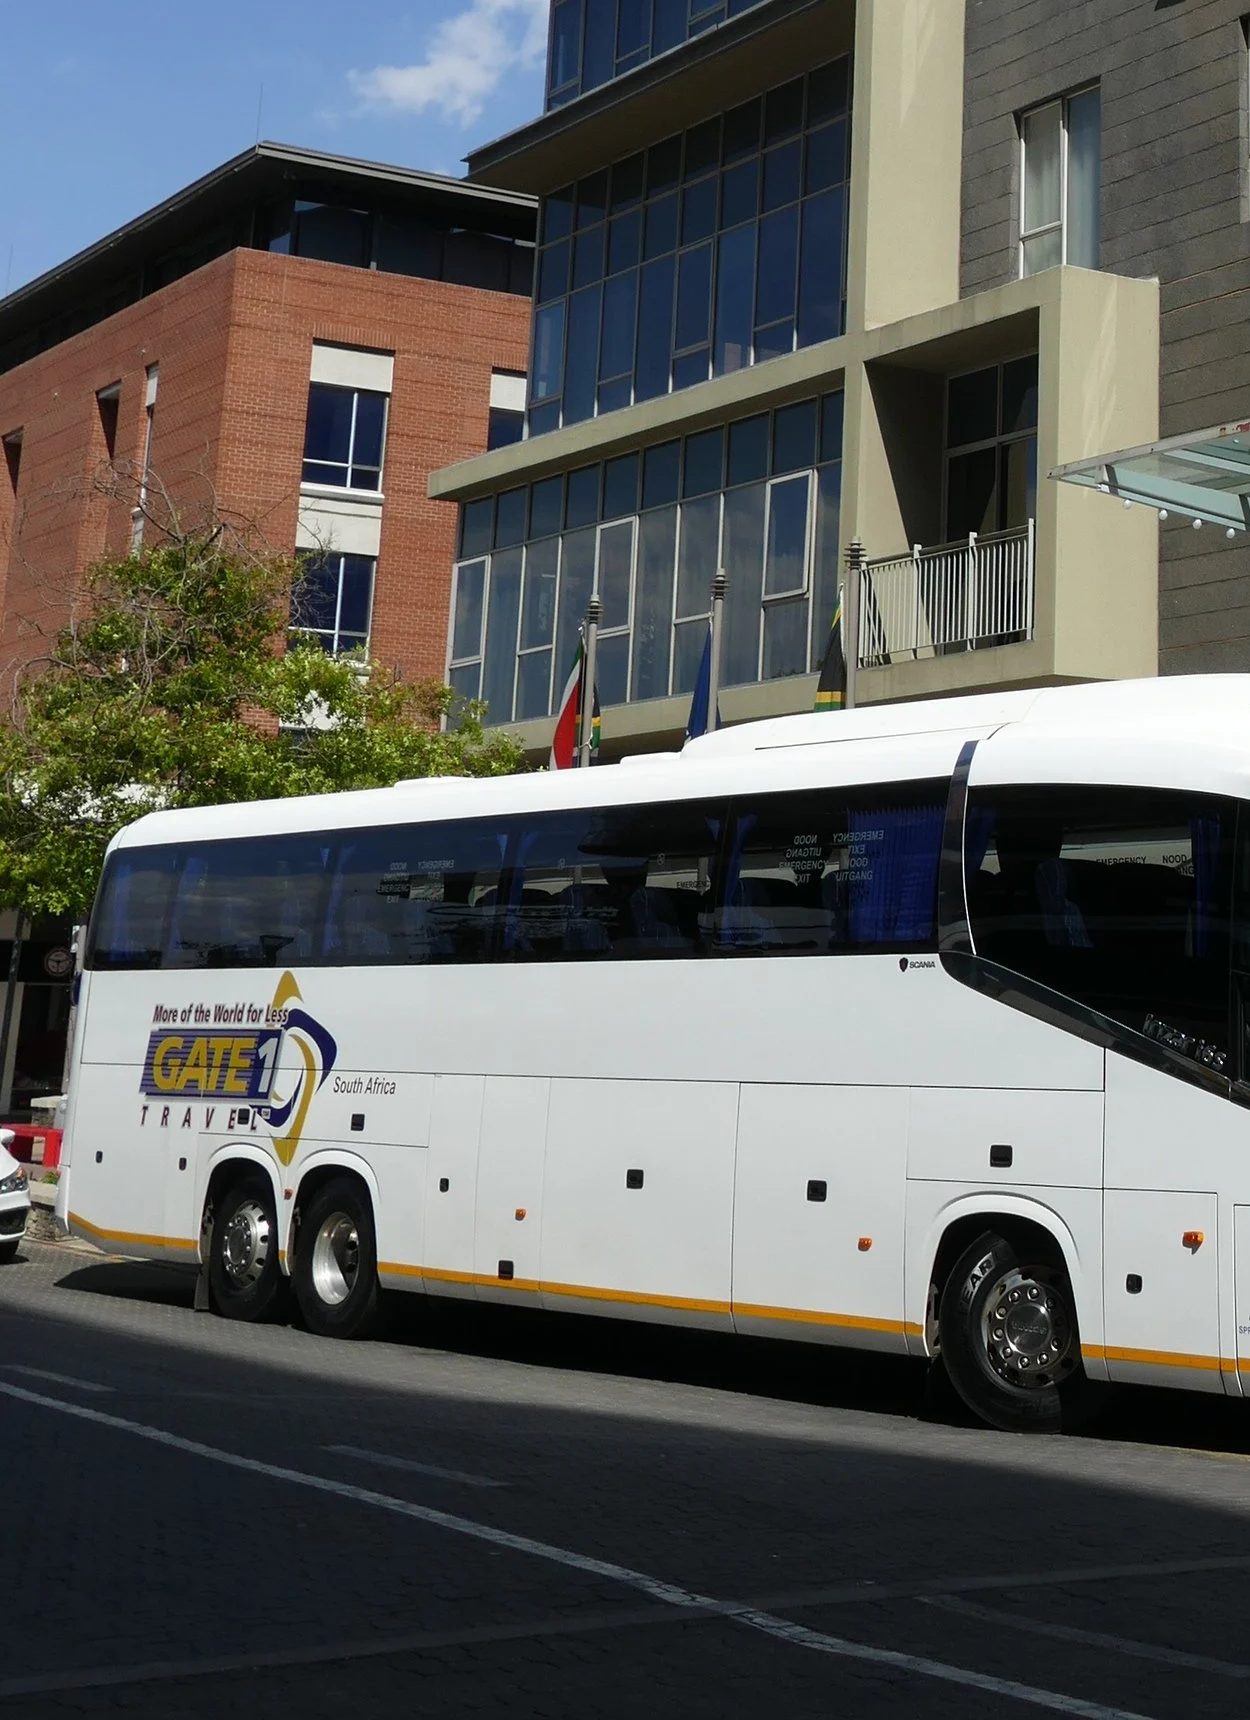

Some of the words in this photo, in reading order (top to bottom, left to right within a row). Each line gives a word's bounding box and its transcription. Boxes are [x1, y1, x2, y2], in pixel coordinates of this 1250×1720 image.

[836, 871, 873, 882] UITGANG
[909, 961, 936, 969] SCANIA
[153, 1005, 178, 1023] More
[180, 1004, 194, 1023] of
[194, 1004, 211, 1022] the
[213, 1004, 246, 1023] World
[247, 1004, 263, 1023] for
[265, 1005, 288, 1023] Less
[153, 1036, 257, 1092] GATE
[258, 1037, 278, 1093] 1
[333, 1076, 363, 1094] South
[364, 1077, 396, 1095] Africa
[140, 1106, 258, 1131] TRAVEL
